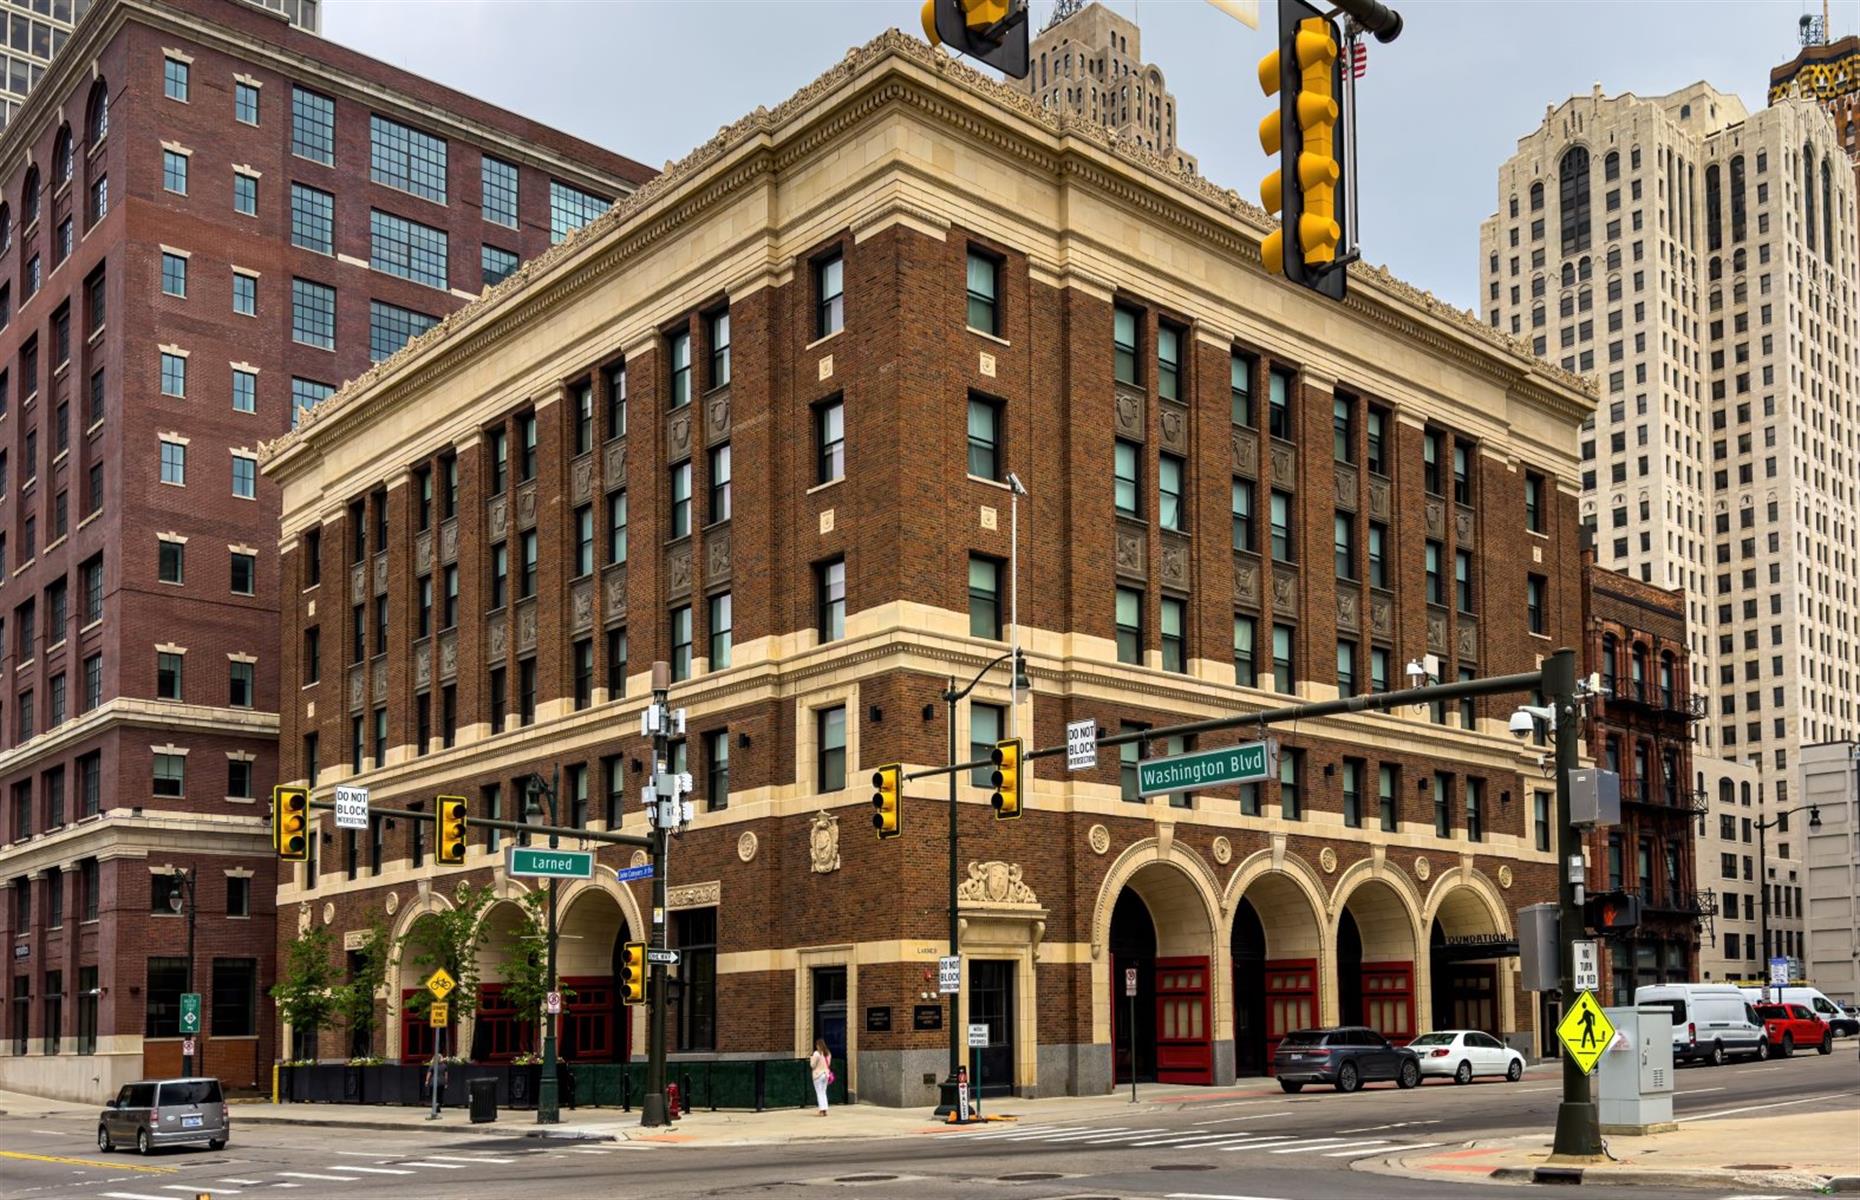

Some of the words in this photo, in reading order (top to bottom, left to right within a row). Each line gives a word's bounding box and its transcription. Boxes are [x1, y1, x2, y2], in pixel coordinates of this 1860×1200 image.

[1069, 729, 1079, 740] DO
[1080, 726, 1094, 738] NOT
[1069, 742, 1094, 756] BLOCK
[1144, 761, 1224, 785] Washington
[1231, 752, 1262, 773] Blvd
[337, 790, 349, 801] DO
[351, 792, 367, 802] NOT
[337, 804, 367, 816] BLOCK
[532, 857, 573, 871] Larned
[1582, 949, 1589, 959] NO
[940, 961, 948, 970] DO
[949, 960, 959, 970] NOT
[1580, 962, 1592, 971] TURN
[940, 972, 959, 982] BLOCK
[1577, 975, 1584, 984] ON
[1587, 974, 1596, 984] RED
